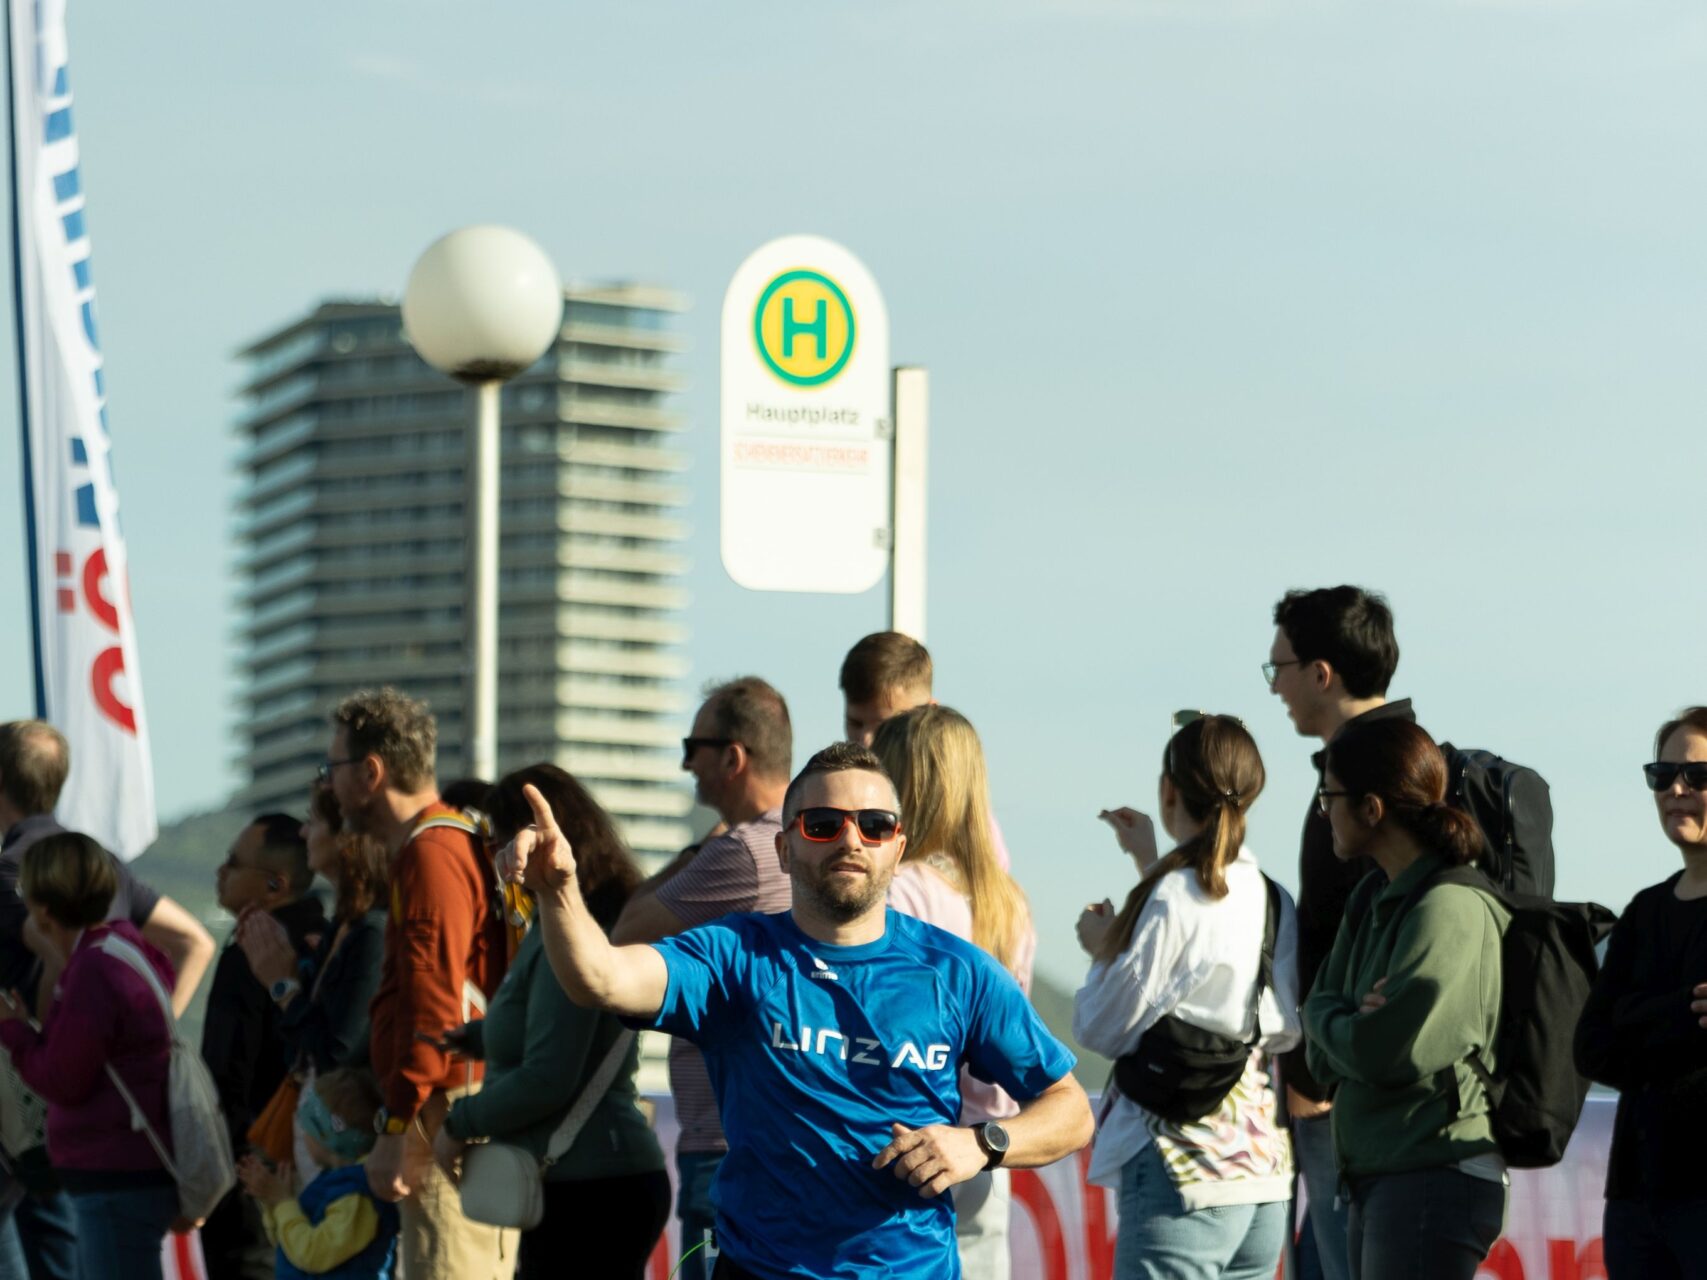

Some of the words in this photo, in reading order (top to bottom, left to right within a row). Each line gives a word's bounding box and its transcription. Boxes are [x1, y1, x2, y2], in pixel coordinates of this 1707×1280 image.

[781, 297, 827, 360] H
[746, 402, 861, 427] Hauptplatz
[891, 1041, 951, 1071] AG
